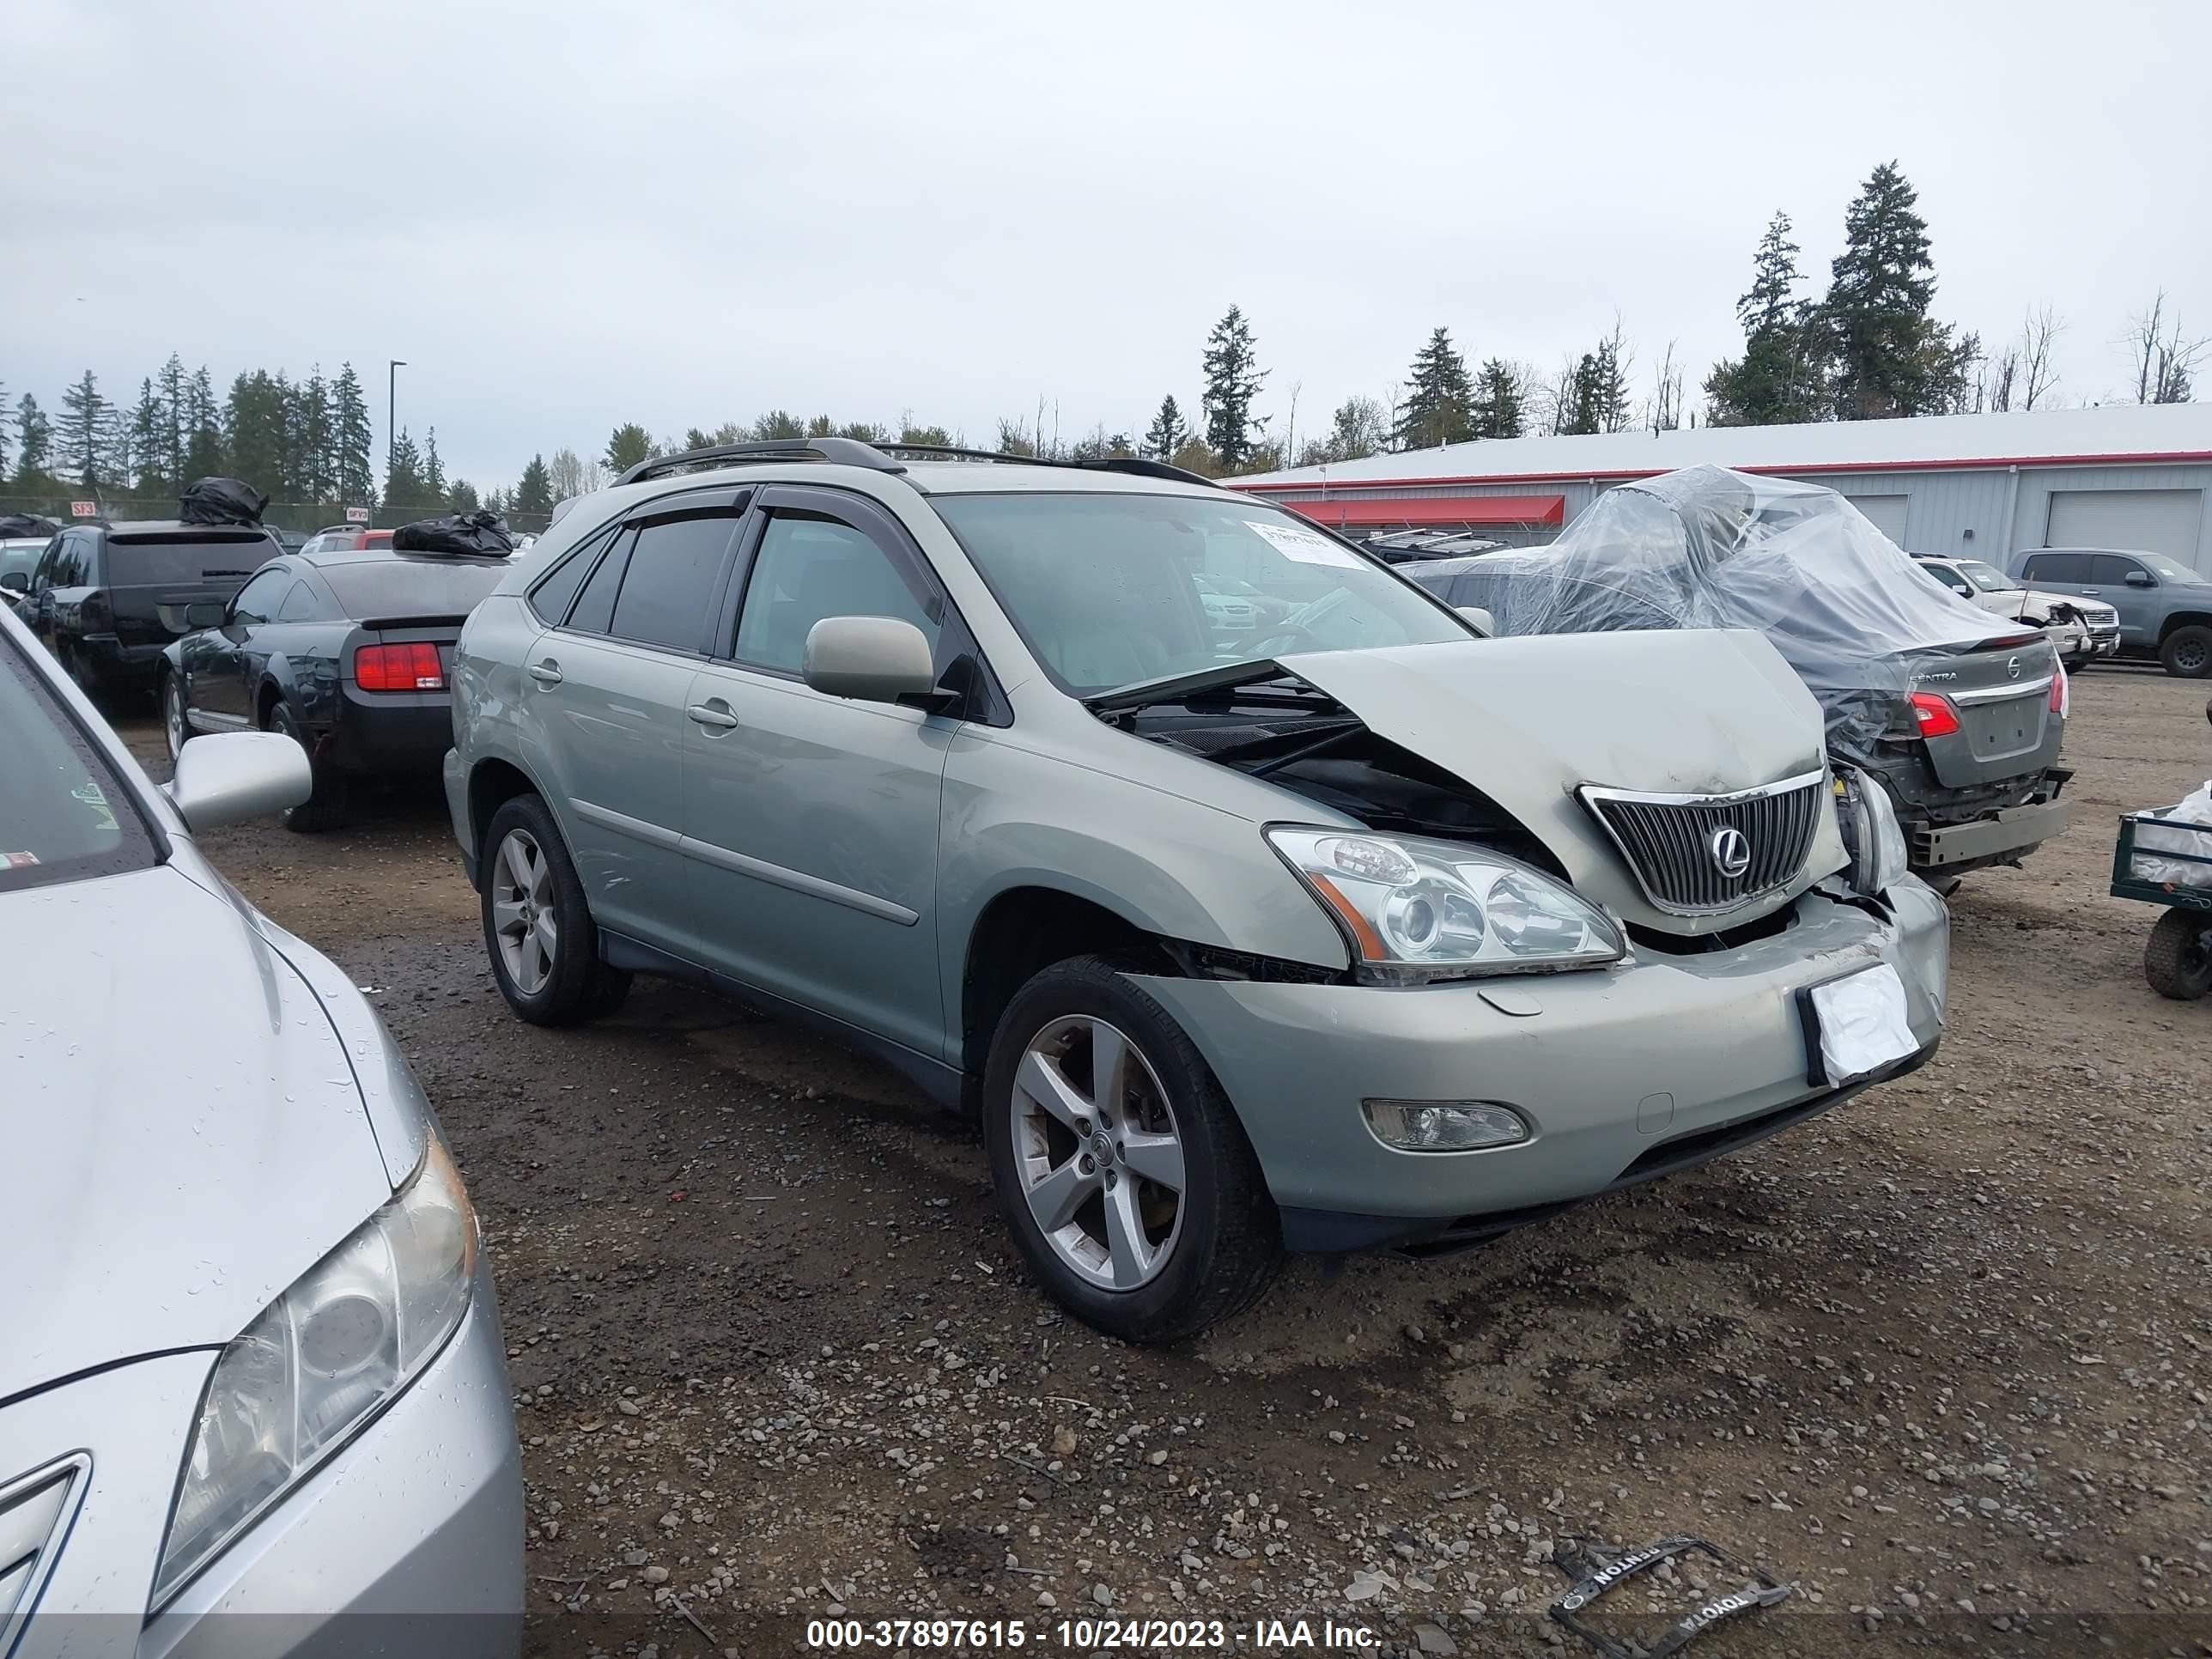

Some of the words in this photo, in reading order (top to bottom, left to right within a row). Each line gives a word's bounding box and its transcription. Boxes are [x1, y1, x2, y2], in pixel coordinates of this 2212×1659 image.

[74, 502, 94, 514] SF3
[1910, 672, 1958, 683] SENTRA
[1594, 1547, 1662, 1585] RENTON
[1680, 1595, 1749, 1632] TOYOTA
